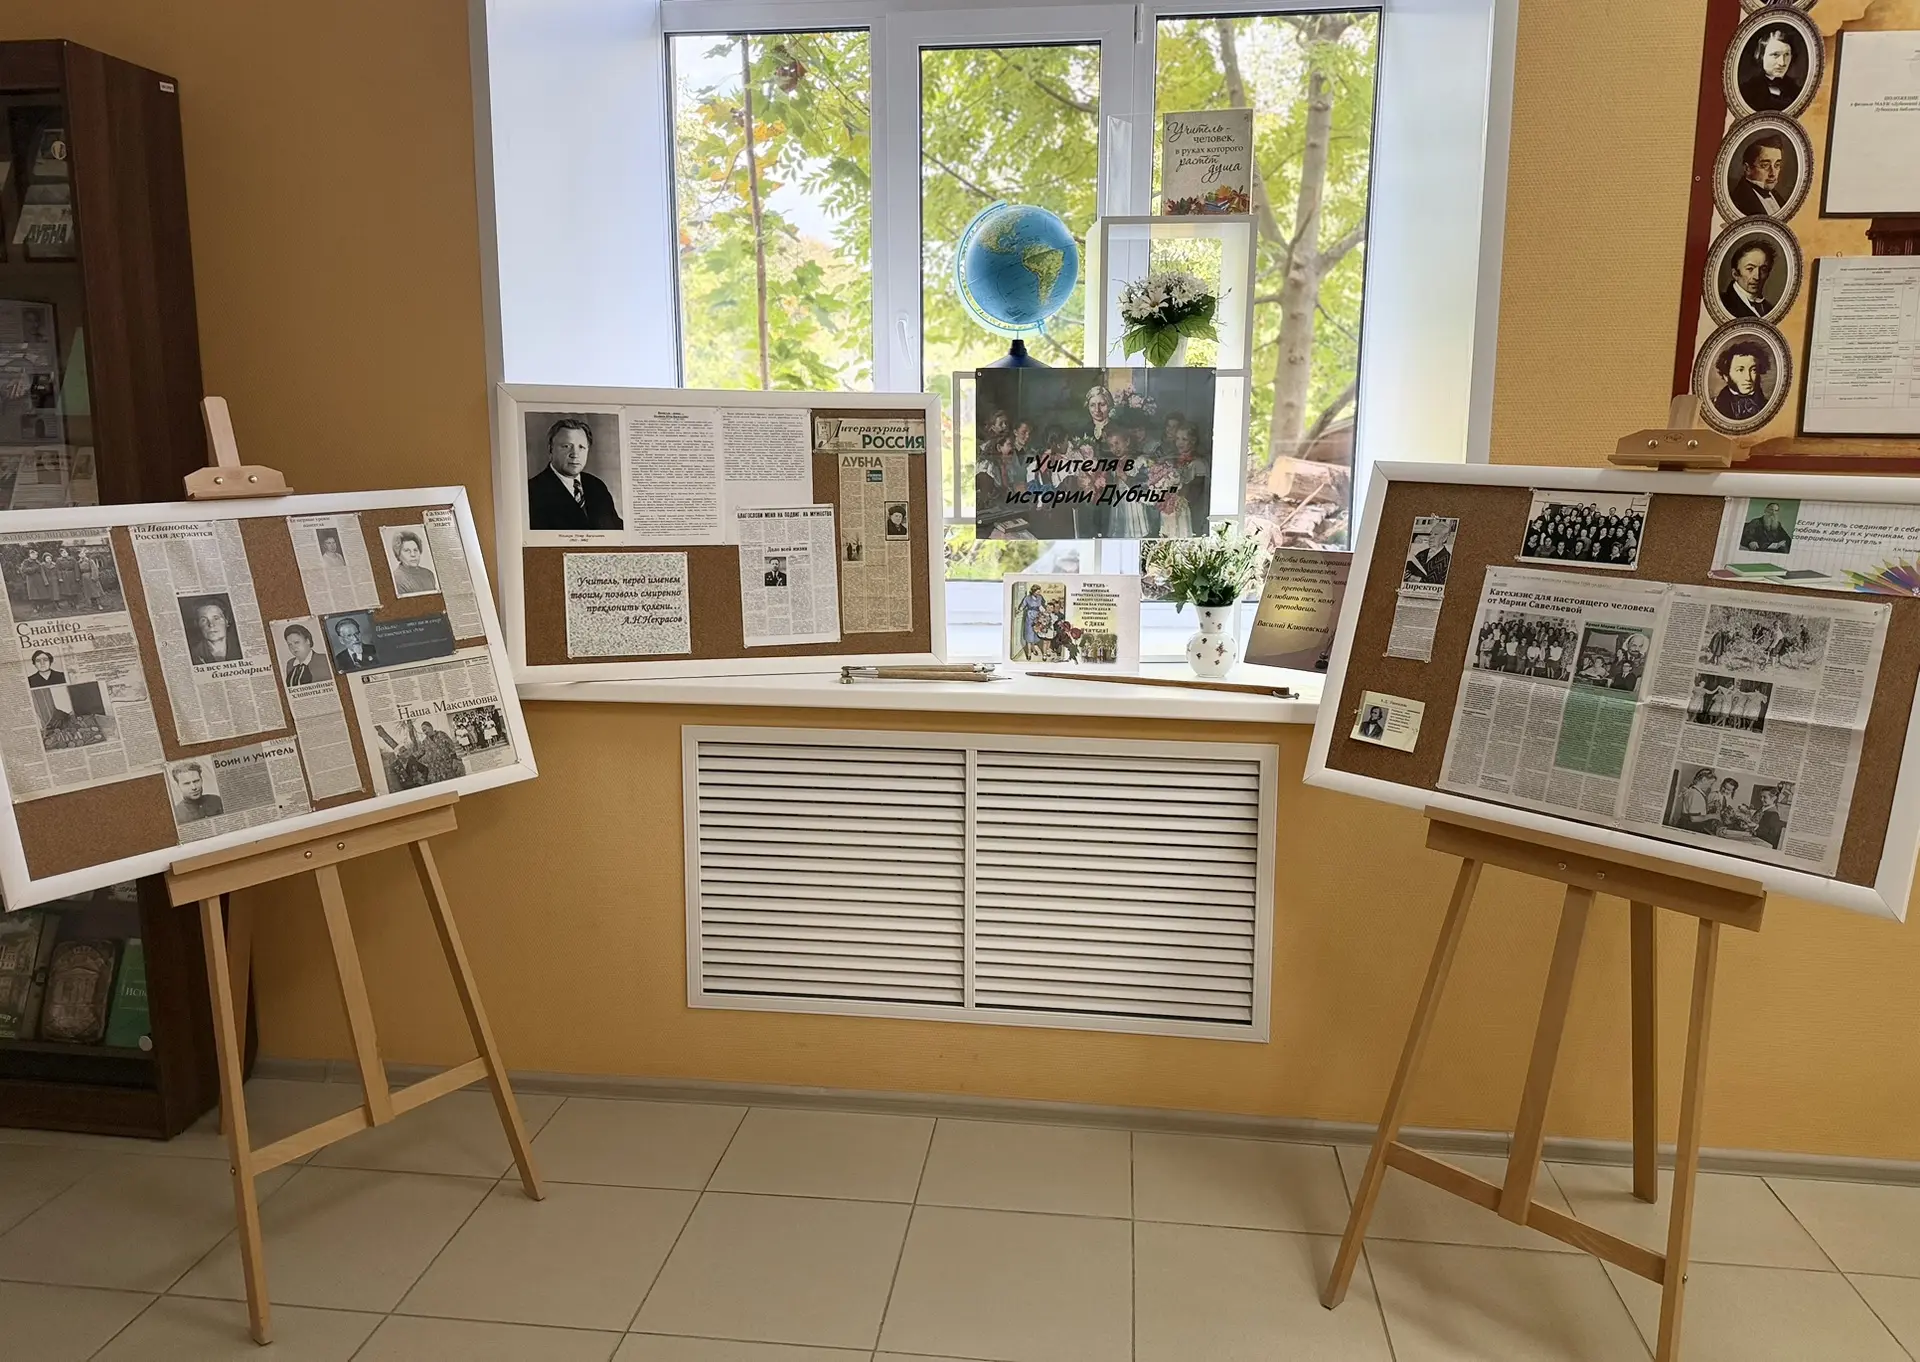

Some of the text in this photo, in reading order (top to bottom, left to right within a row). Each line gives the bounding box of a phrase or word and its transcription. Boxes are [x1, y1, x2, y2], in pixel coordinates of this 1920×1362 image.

[1167, 121, 1223, 143] Учитель
[1193, 134, 1236, 144] человек,
[1181, 147, 1205, 156] руках
[1206, 145, 1244, 155] которого
[1201, 162, 1243, 184] душа
[862, 433, 925, 449] РОССИЯ
[841, 456, 884, 468] ДУБНА
[1025, 454, 1135, 473] "Учителя в
[1005, 483, 1178, 509] истории Дубны"
[147, 524, 200, 534] Ивановых
[1816, 520, 1848, 529] учитель
[1849, 523, 1892, 532] соединяет
[134, 531, 214, 541] Россия держится
[1792, 534, 1845, 543] совершенный
[1829, 529, 1847, 537] делу
[1864, 532, 1905, 541] ученикам,
[1274, 555, 1298, 564] Чтобы
[1299, 557, 1318, 565] быть
[1279, 566, 1338, 576] преподавателем,
[577, 575, 681, 587] Учитель, перед именем
[1290, 575, 1318, 584] любить
[1402, 582, 1444, 594] Директор
[570, 589, 682, 600] твоим, позволь смиренно
[1272, 593, 1300, 601] любить
[1489, 587, 1655, 614] Катехизис для настоящего человека
[586, 604, 639, 614] преклонить
[1499, 596, 1527, 608] Марии
[1528, 600, 1583, 615] Савельевой
[16, 619, 81, 636] Снайпер
[1257, 619, 1330, 634] Василий Ключевский
[19, 632, 96, 650] Важенина
[194, 660, 254, 674] За все мы Вас
[211, 664, 273, 680] благодарим!
[287, 681, 335, 694] Беспокойные
[291, 687, 334, 699] хлопоты эти
[398, 694, 499, 720] Наша Максимовна
[213, 746, 295, 769] Воин и учитель
